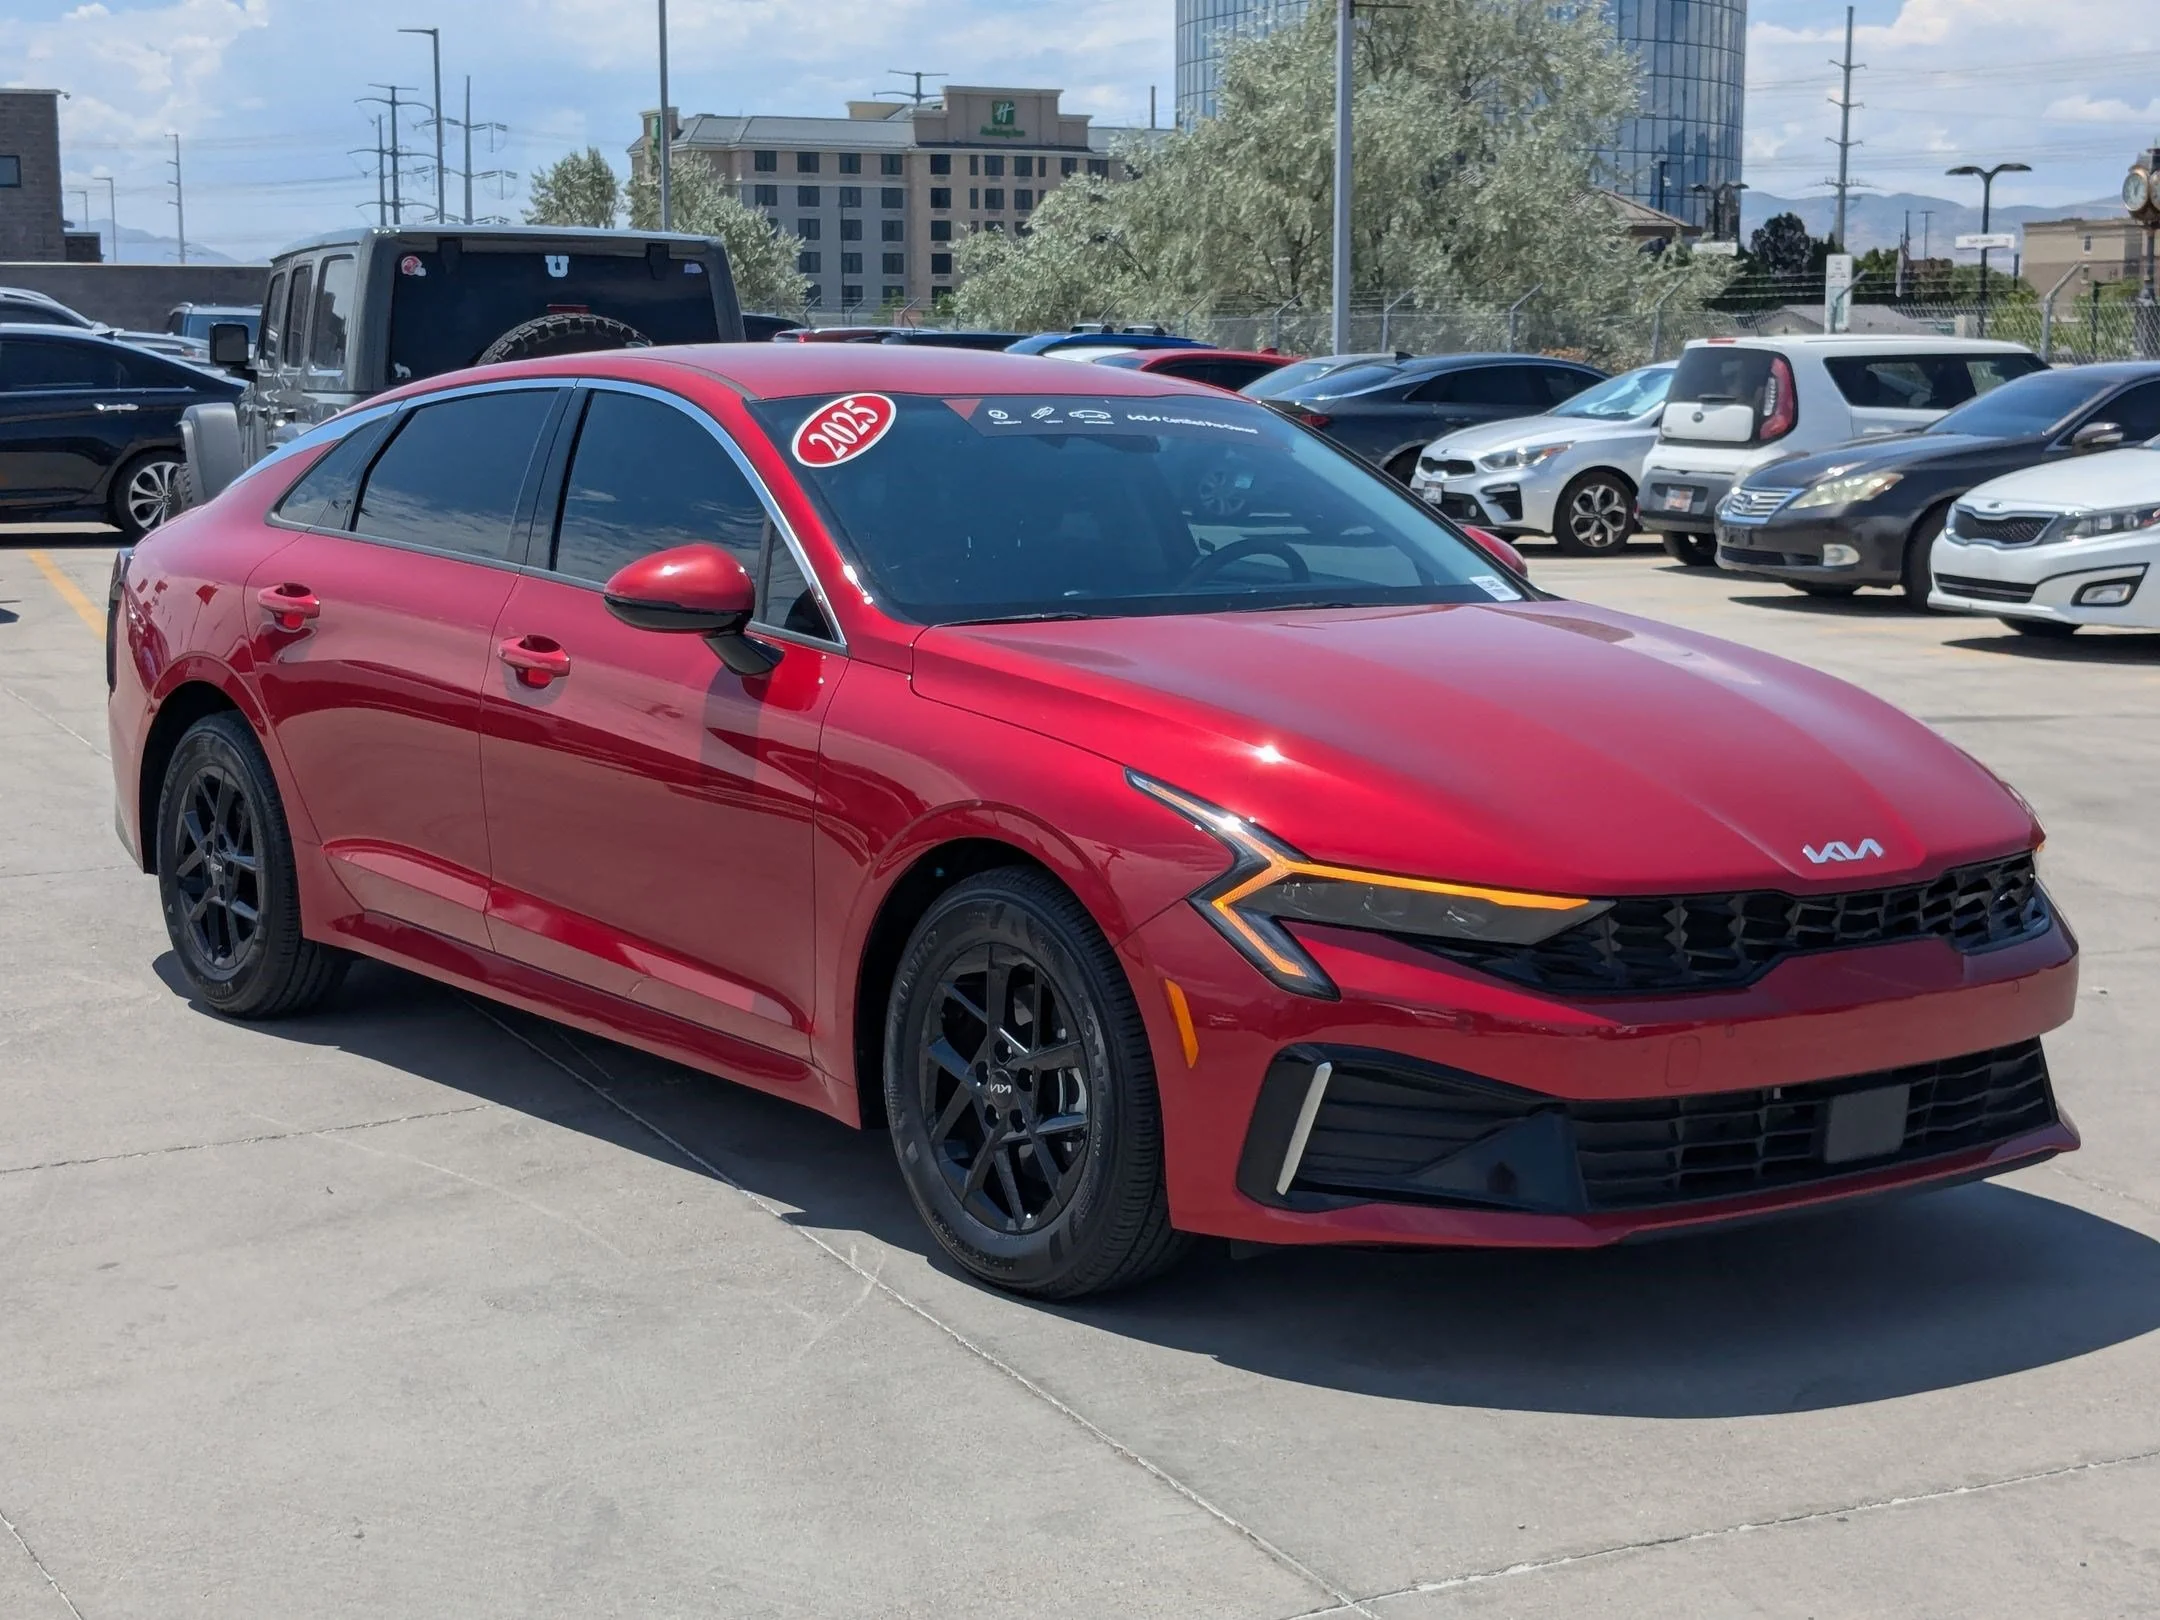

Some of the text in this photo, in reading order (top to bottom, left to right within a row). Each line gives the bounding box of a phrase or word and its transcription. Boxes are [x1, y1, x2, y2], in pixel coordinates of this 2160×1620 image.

[544, 255, 570, 278] U
[808, 399, 879, 460] 2025
[1801, 838, 1884, 864] KIA
